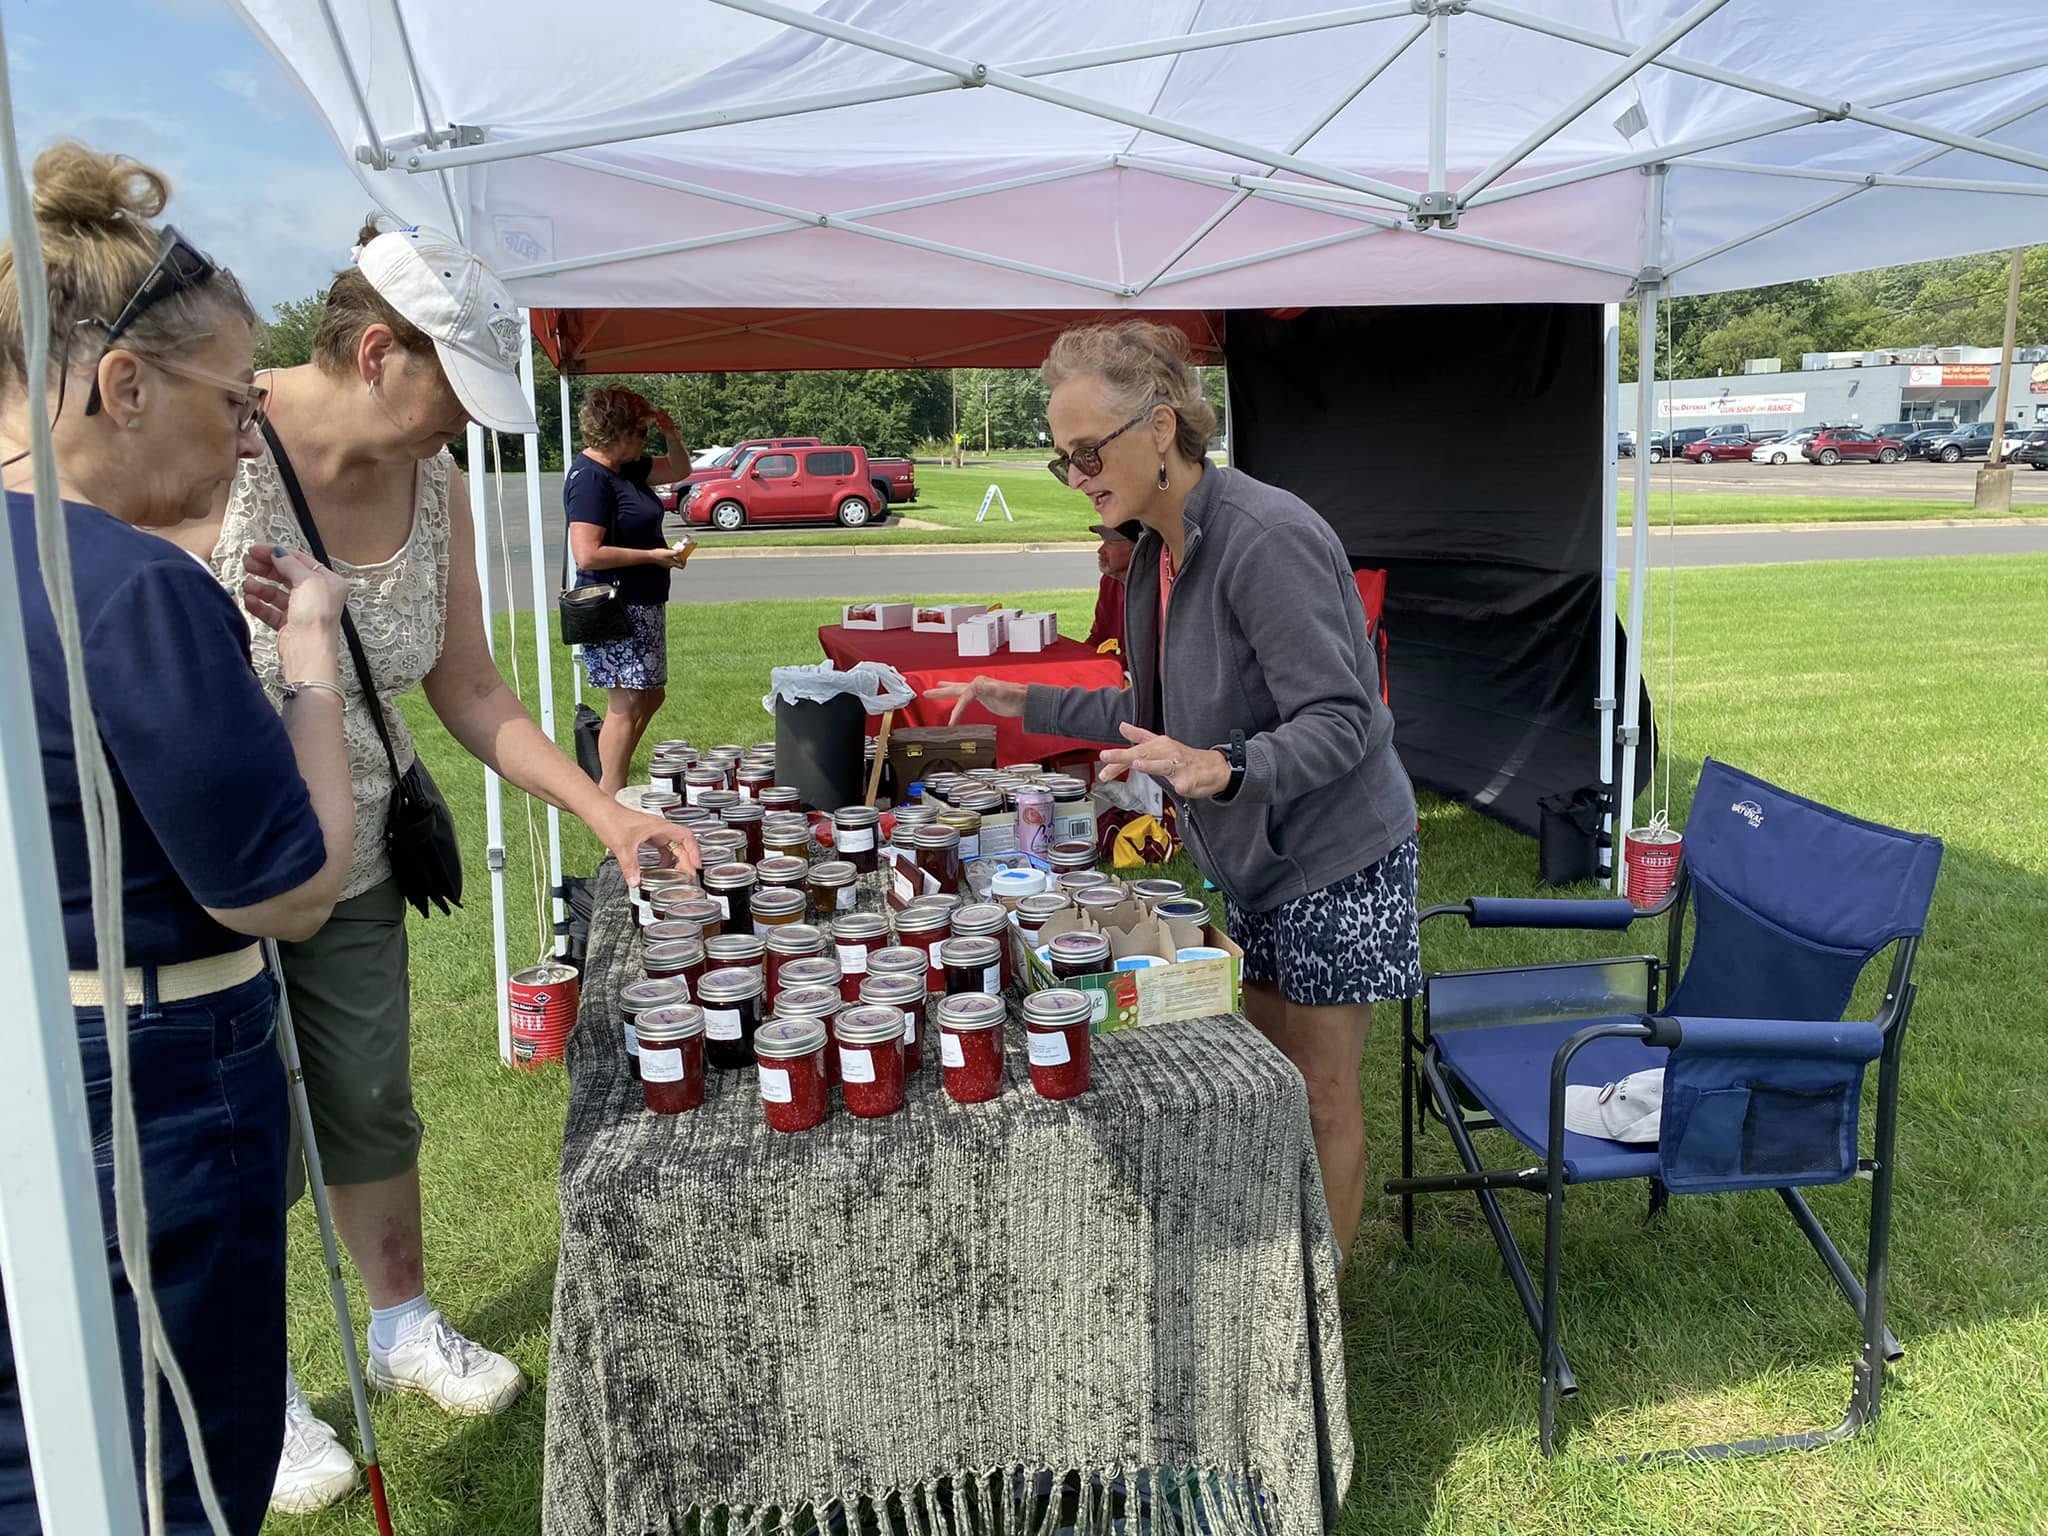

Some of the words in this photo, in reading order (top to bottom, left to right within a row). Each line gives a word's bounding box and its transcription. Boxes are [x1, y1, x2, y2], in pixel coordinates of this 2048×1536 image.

[1681, 403, 1706, 411] DEFENSE
[1719, 406, 1734, 414] GUN
[1736, 405, 1756, 413] SHOP
[1767, 404, 1793, 412] RANGE
